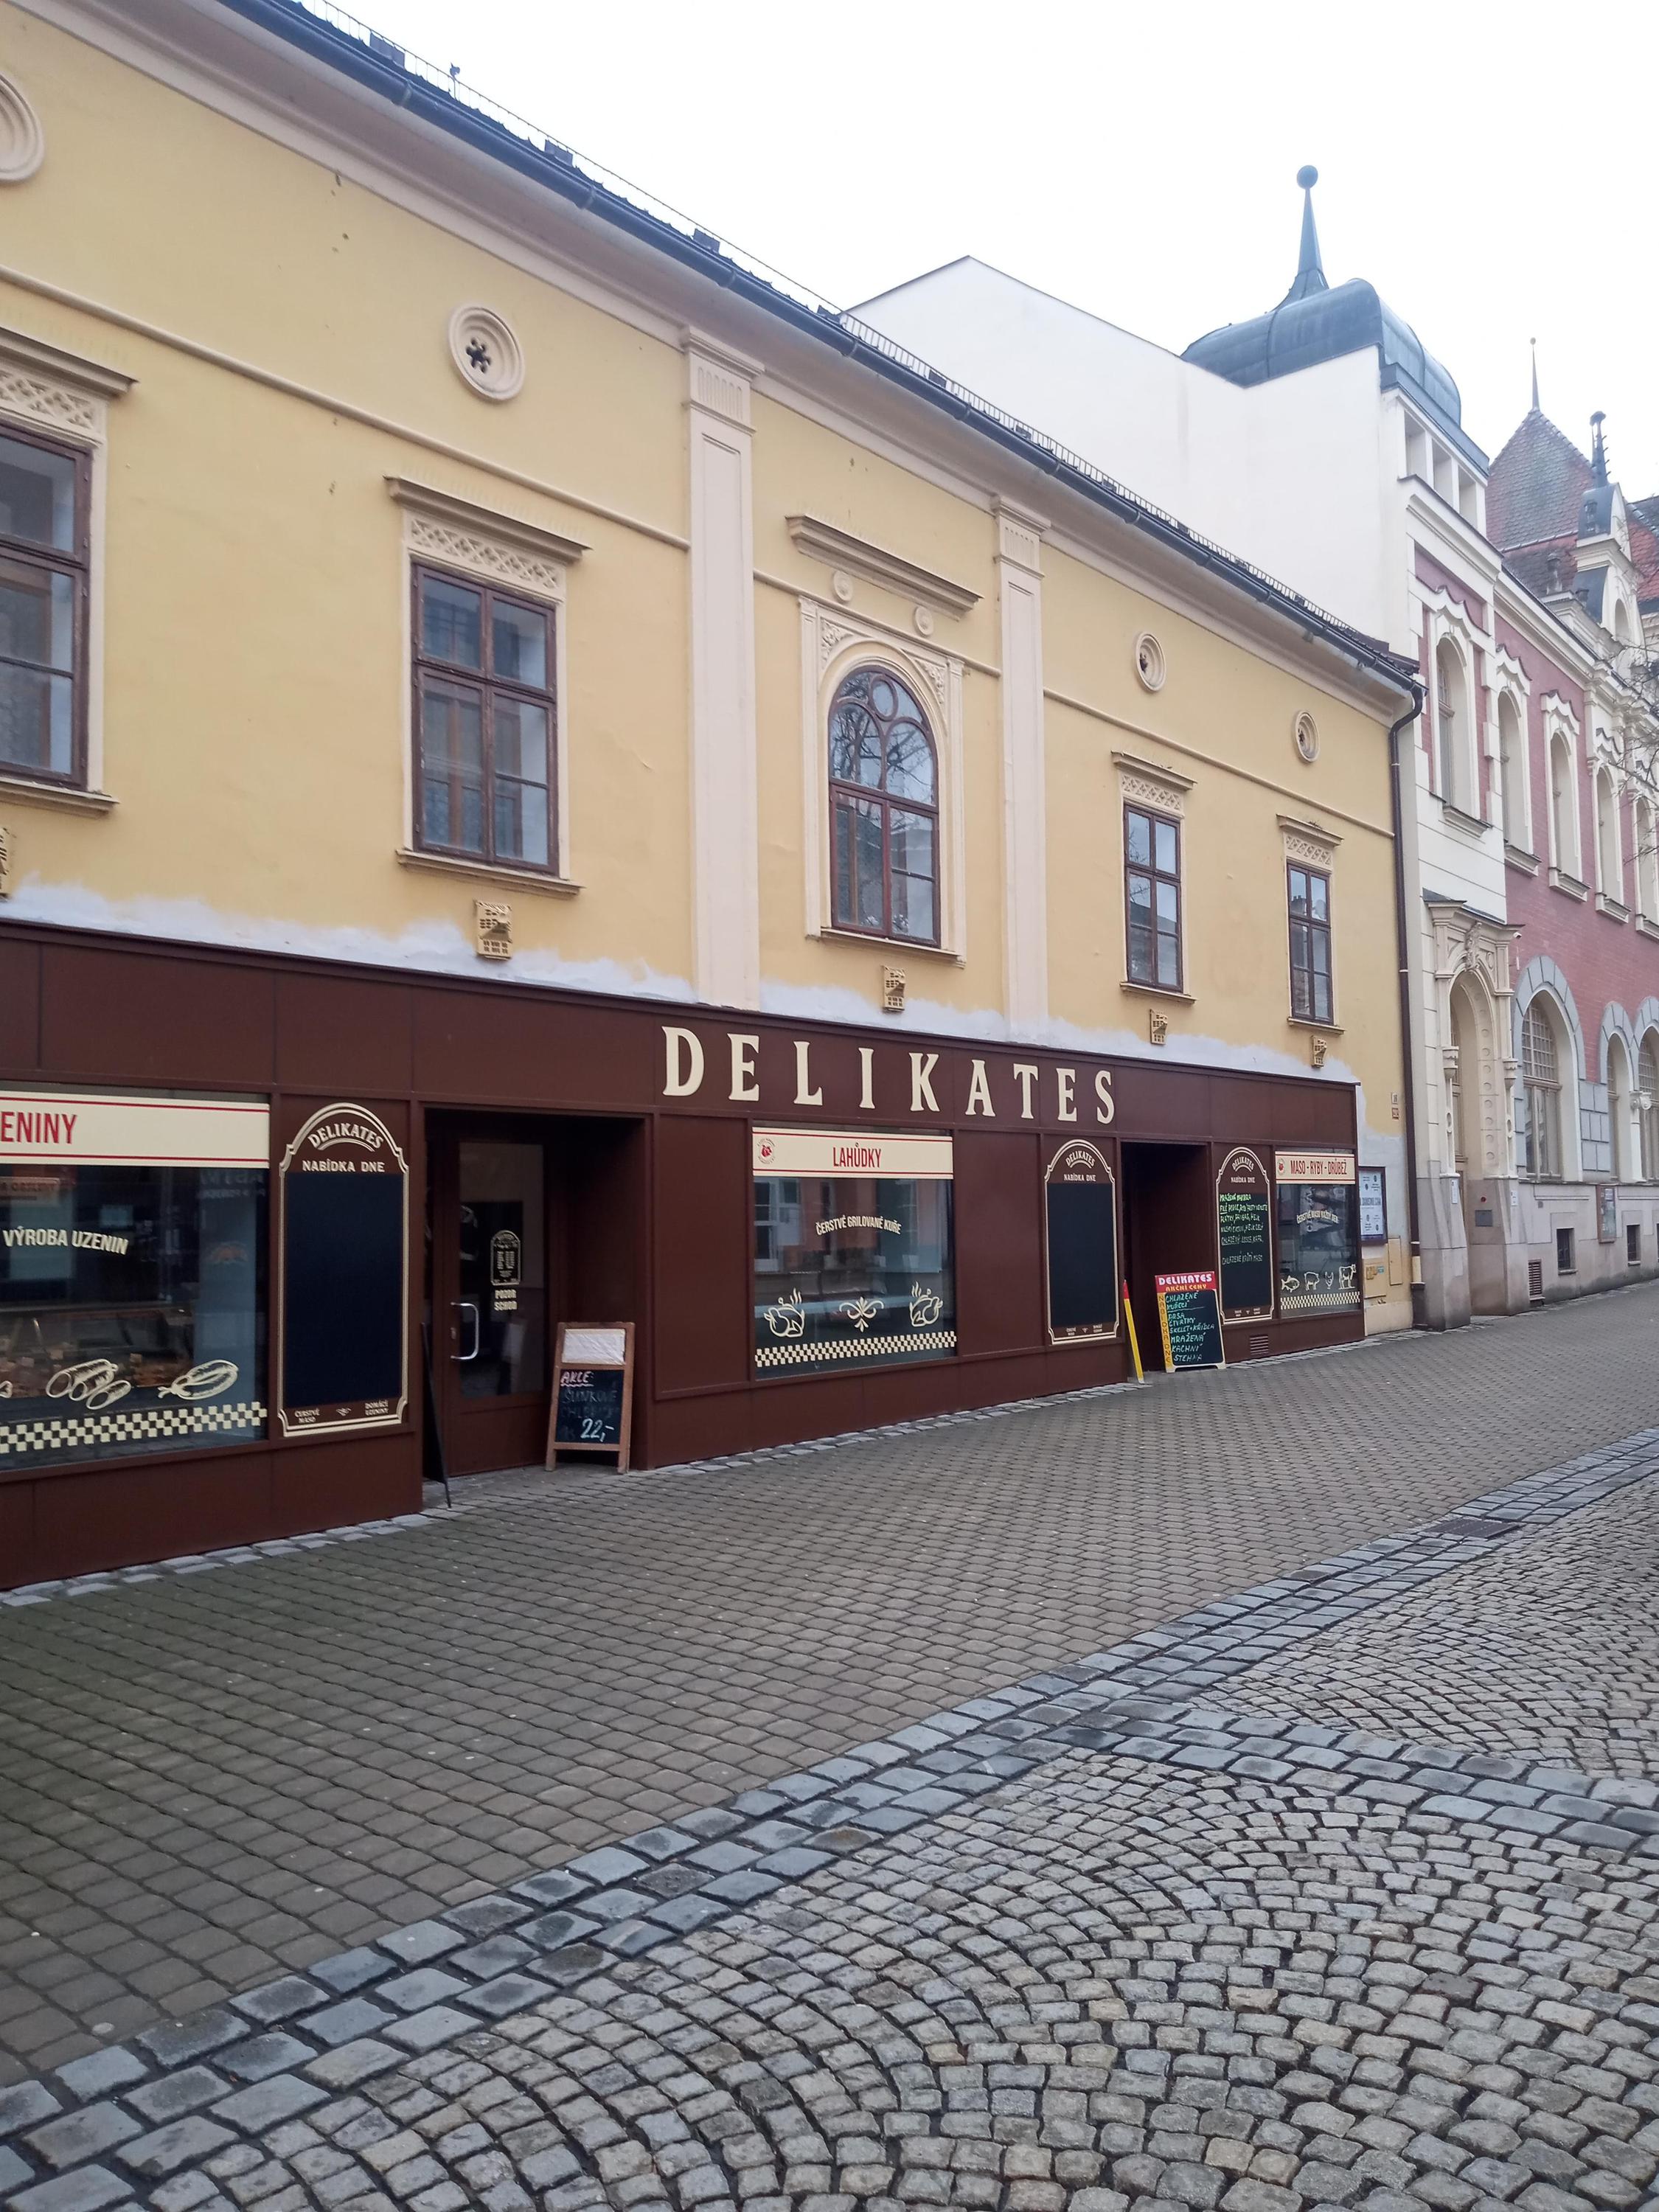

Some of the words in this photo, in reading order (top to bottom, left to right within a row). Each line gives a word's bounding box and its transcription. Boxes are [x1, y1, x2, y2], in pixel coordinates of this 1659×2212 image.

[662, 1026, 1115, 1124] DELIKATES
[1, 1111, 77, 1144] ENINY
[307, 1122, 383, 1149] DELIKATES
[832, 1142, 882, 1169] LAHŮDKY
[1065, 1150, 1095, 1166] DELIKATES
[302, 1158, 355, 1172] NABÍDKA
[361, 1161, 385, 1172] DNE
[1231, 1156, 1254, 1171] DELIKATES
[1290, 1160, 1306, 1175] MASO
[1310, 1161, 1324, 1175] RYBY
[1064, 1172, 1085, 1181] NABÍDKA
[1086, 1174, 1096, 1182] DNE
[815, 1214, 846, 1235] ČERSTVÉ
[847, 1215, 883, 1229] GRILOVANÉ
[884, 1219, 902, 1235] KUŘE
[3, 1225, 68, 1247] VÝROBA
[72, 1231, 128, 1255] UZENIN
[1158, 1273, 1212, 1286] DELIKATES
[1166, 1290, 1199, 1303] CHLAZENÉ
[1171, 1332, 1206, 1343] MRAŽENÁ
